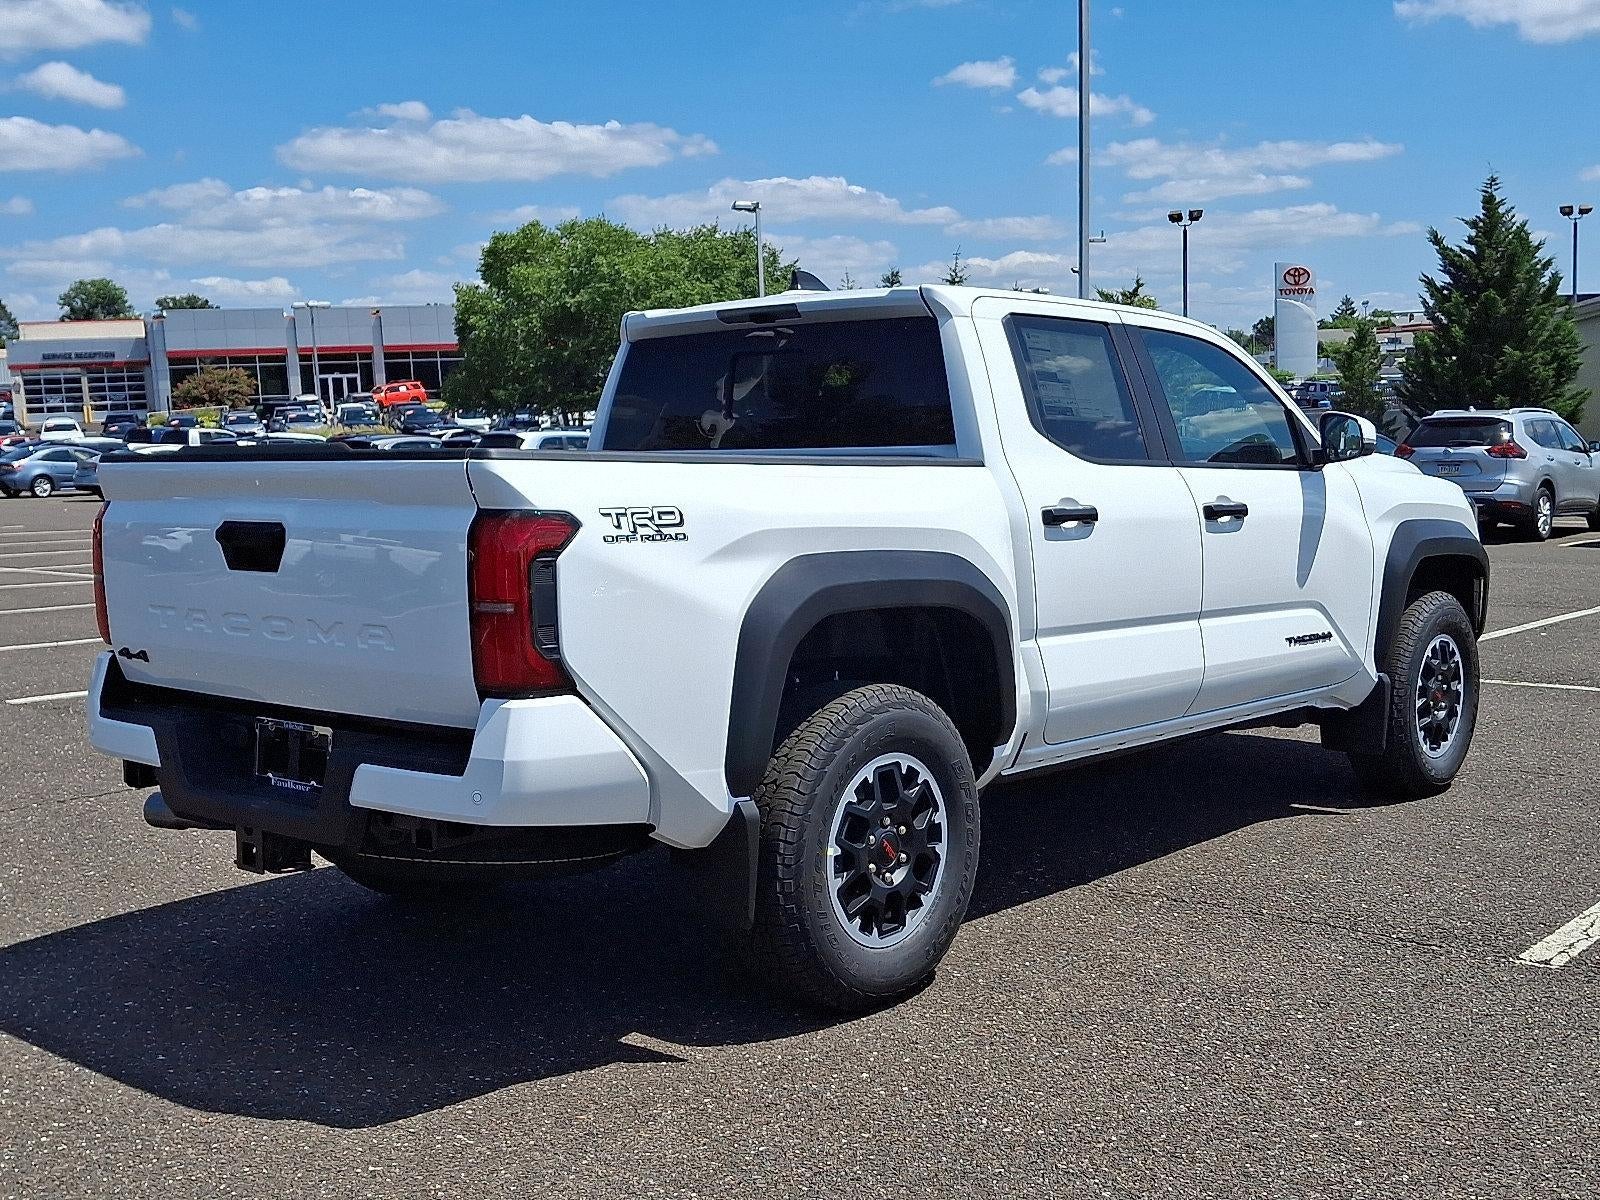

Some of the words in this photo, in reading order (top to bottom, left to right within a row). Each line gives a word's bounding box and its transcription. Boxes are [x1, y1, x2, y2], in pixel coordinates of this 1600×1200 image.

[1278, 287, 1315, 296] TOYOTA
[42, 352, 73, 360] SERVICE
[74, 351, 115, 359] RECEPTION
[598, 506, 684, 535] TRD
[603, 533, 638, 545] OFF
[639, 532, 689, 544] ROAD
[148, 604, 395, 651] TACOMA
[1285, 631, 1333, 647] TACOMA
[271, 778, 311, 792] Faulkner
